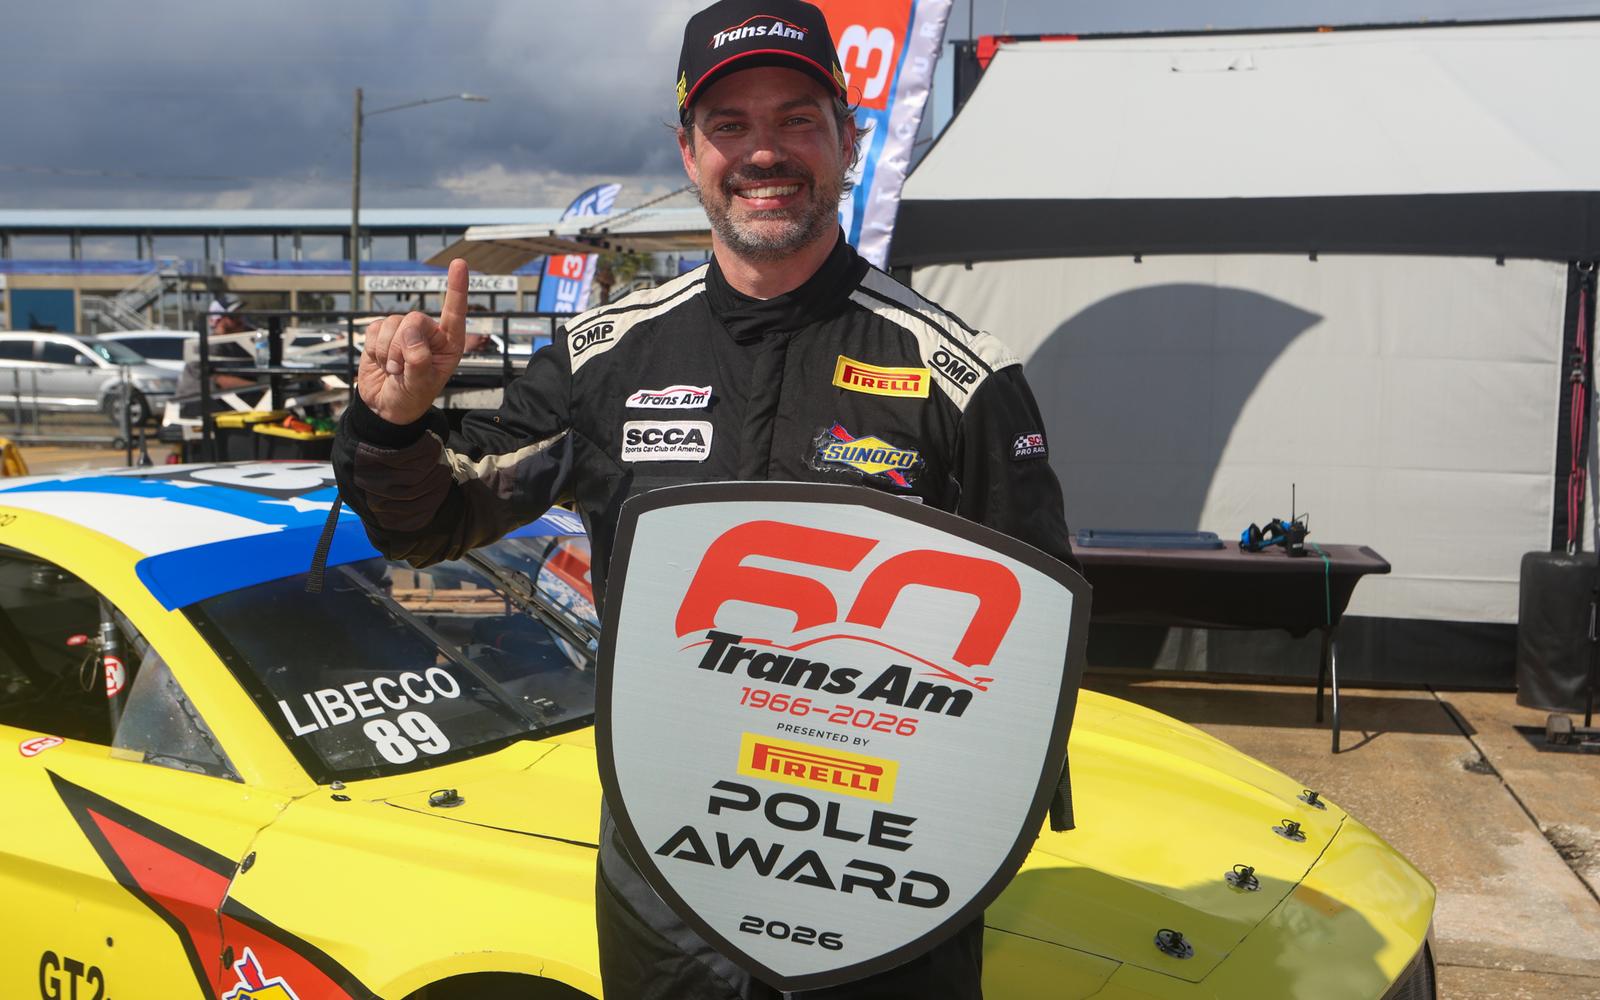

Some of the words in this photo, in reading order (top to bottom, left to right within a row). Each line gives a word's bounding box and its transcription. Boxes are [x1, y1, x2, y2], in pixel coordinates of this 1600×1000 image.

[712, 25, 766, 49] Trans
[770, 22, 804, 42] Am
[838, 24, 894, 100] 3
[369, 278, 428, 289] GURNEY
[437, 278, 503, 289] TRACE
[572, 324, 615, 351] OMP
[842, 364, 921, 392] PIRELLI
[932, 350, 980, 386] OMP
[638, 393, 678, 405] Trans
[680, 393, 704, 405] Am
[625, 446, 642, 454] Sports
[678, 445, 705, 453] America
[626, 428, 706, 446] SCCA
[1015, 447, 1032, 456] PRO
[826, 444, 914, 468] SUNOCO
[675, 520, 1021, 667] 60
[698, 630, 863, 695] Trans
[857, 664, 973, 717] Am
[277, 667, 461, 736] LIBECCO
[363, 711, 450, 764] 89
[777, 722, 849, 744] PRESENTED
[853, 737, 870, 748] BY
[751, 743, 883, 792] PIRELLI
[708, 780, 918, 851] POLE
[654, 825, 950, 908] AWARD
[739, 915, 844, 951] 2026
